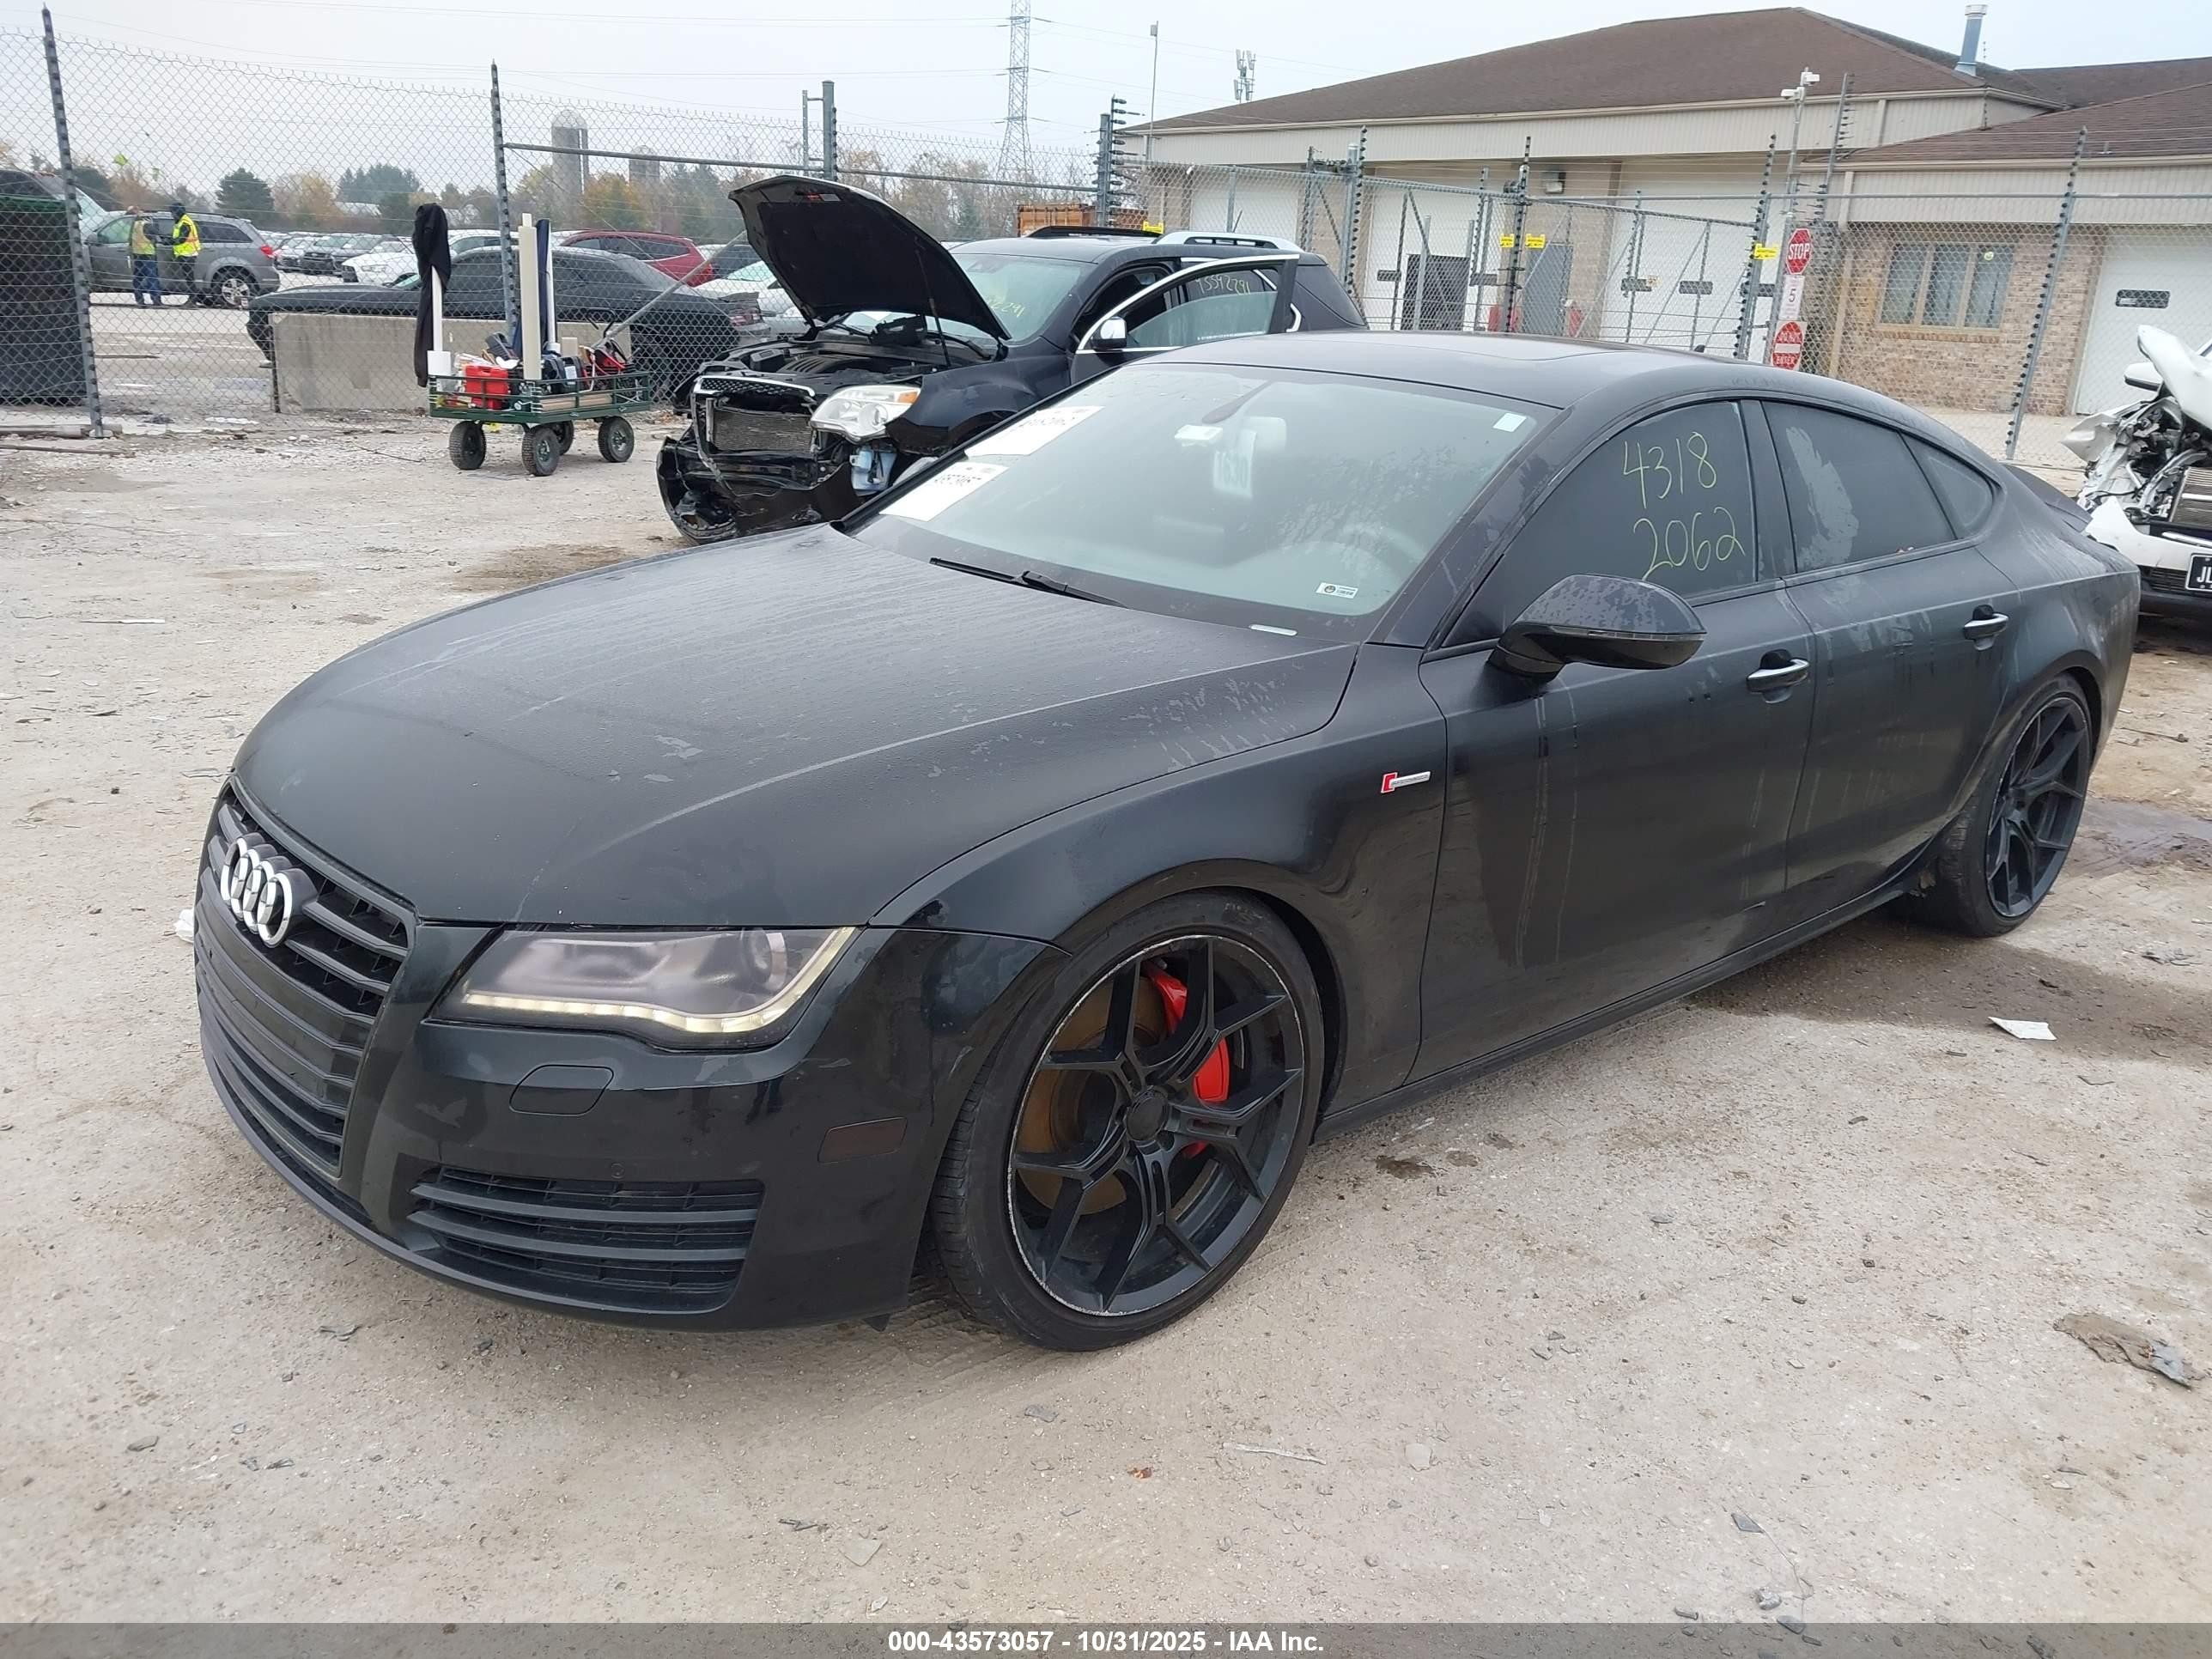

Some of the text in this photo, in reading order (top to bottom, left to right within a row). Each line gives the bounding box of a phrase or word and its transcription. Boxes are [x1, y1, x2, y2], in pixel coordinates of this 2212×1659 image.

[1788, 243, 1809, 260] STOP
[1788, 288, 1796, 303] 5
[1622, 431, 1717, 509] 4318
[1632, 506, 1747, 581] 2062
